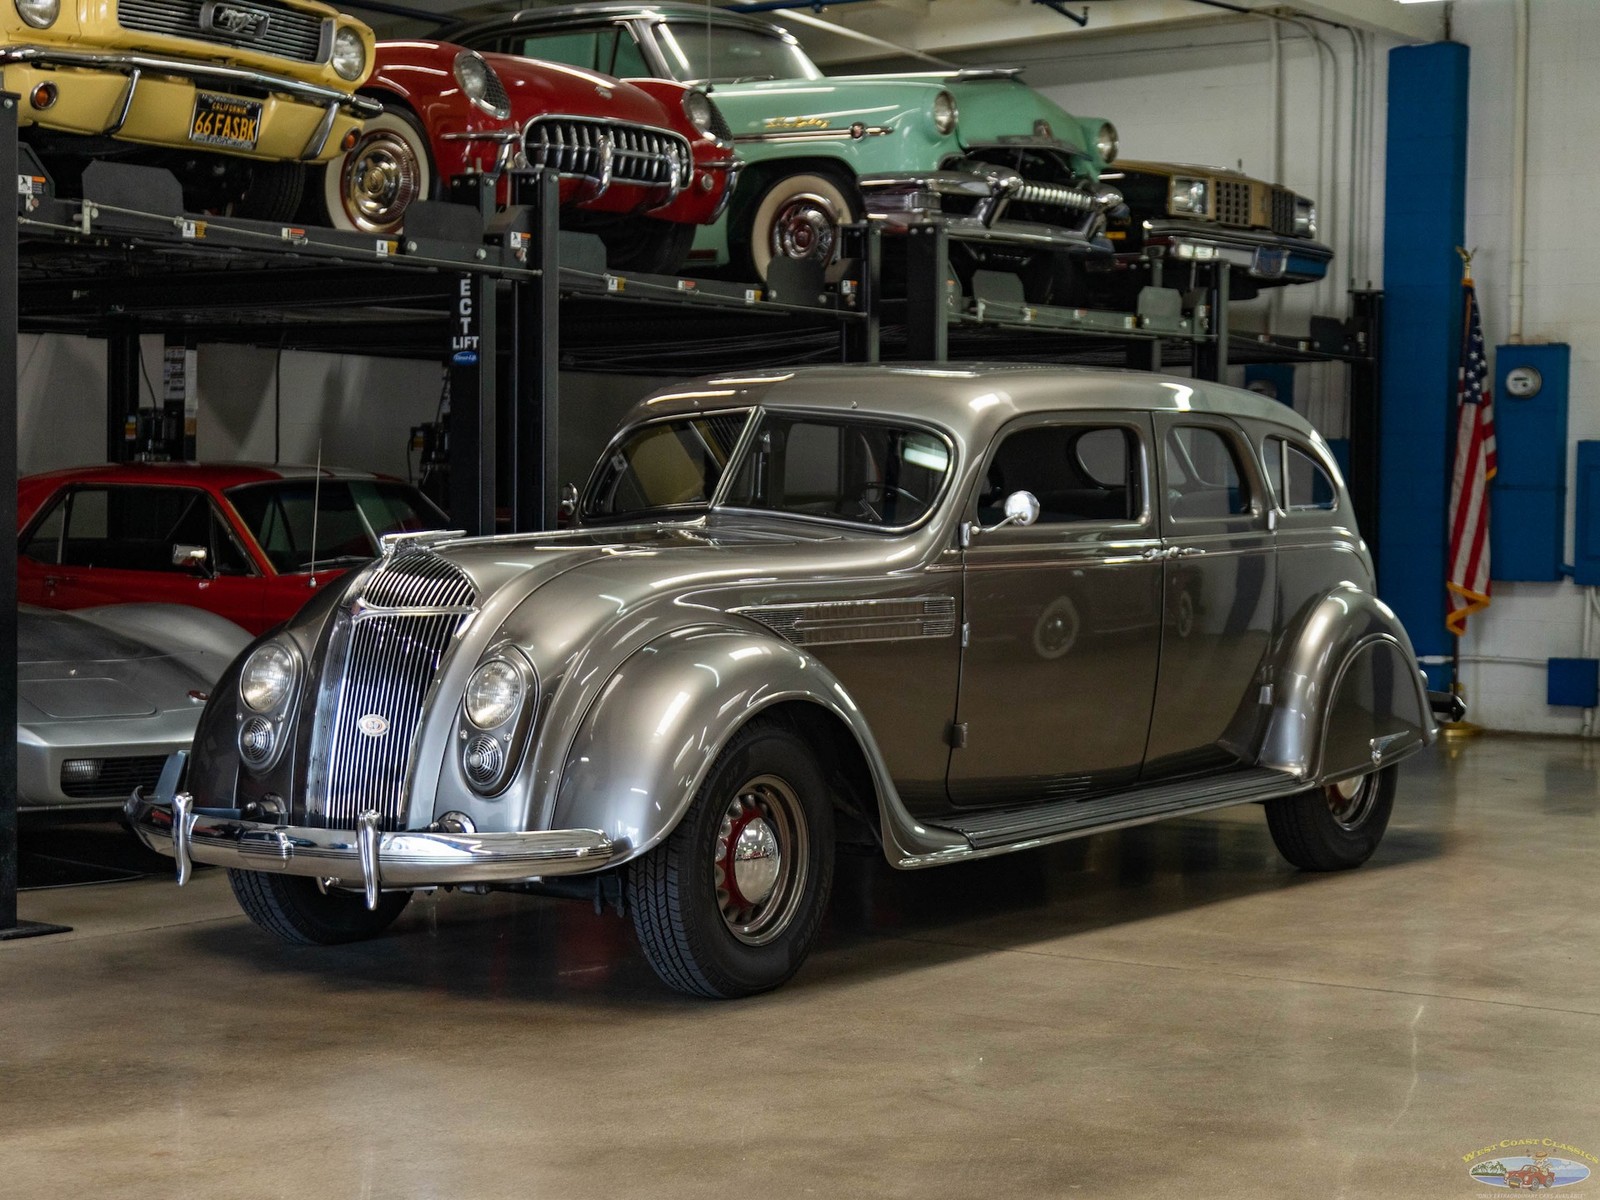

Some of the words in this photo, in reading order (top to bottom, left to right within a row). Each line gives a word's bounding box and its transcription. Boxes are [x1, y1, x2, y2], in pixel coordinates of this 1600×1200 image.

[195, 111, 214, 136] 66
[214, 113, 256, 142] FASBK
[460, 272, 472, 334] ECT
[452, 336, 479, 350] LIFT
